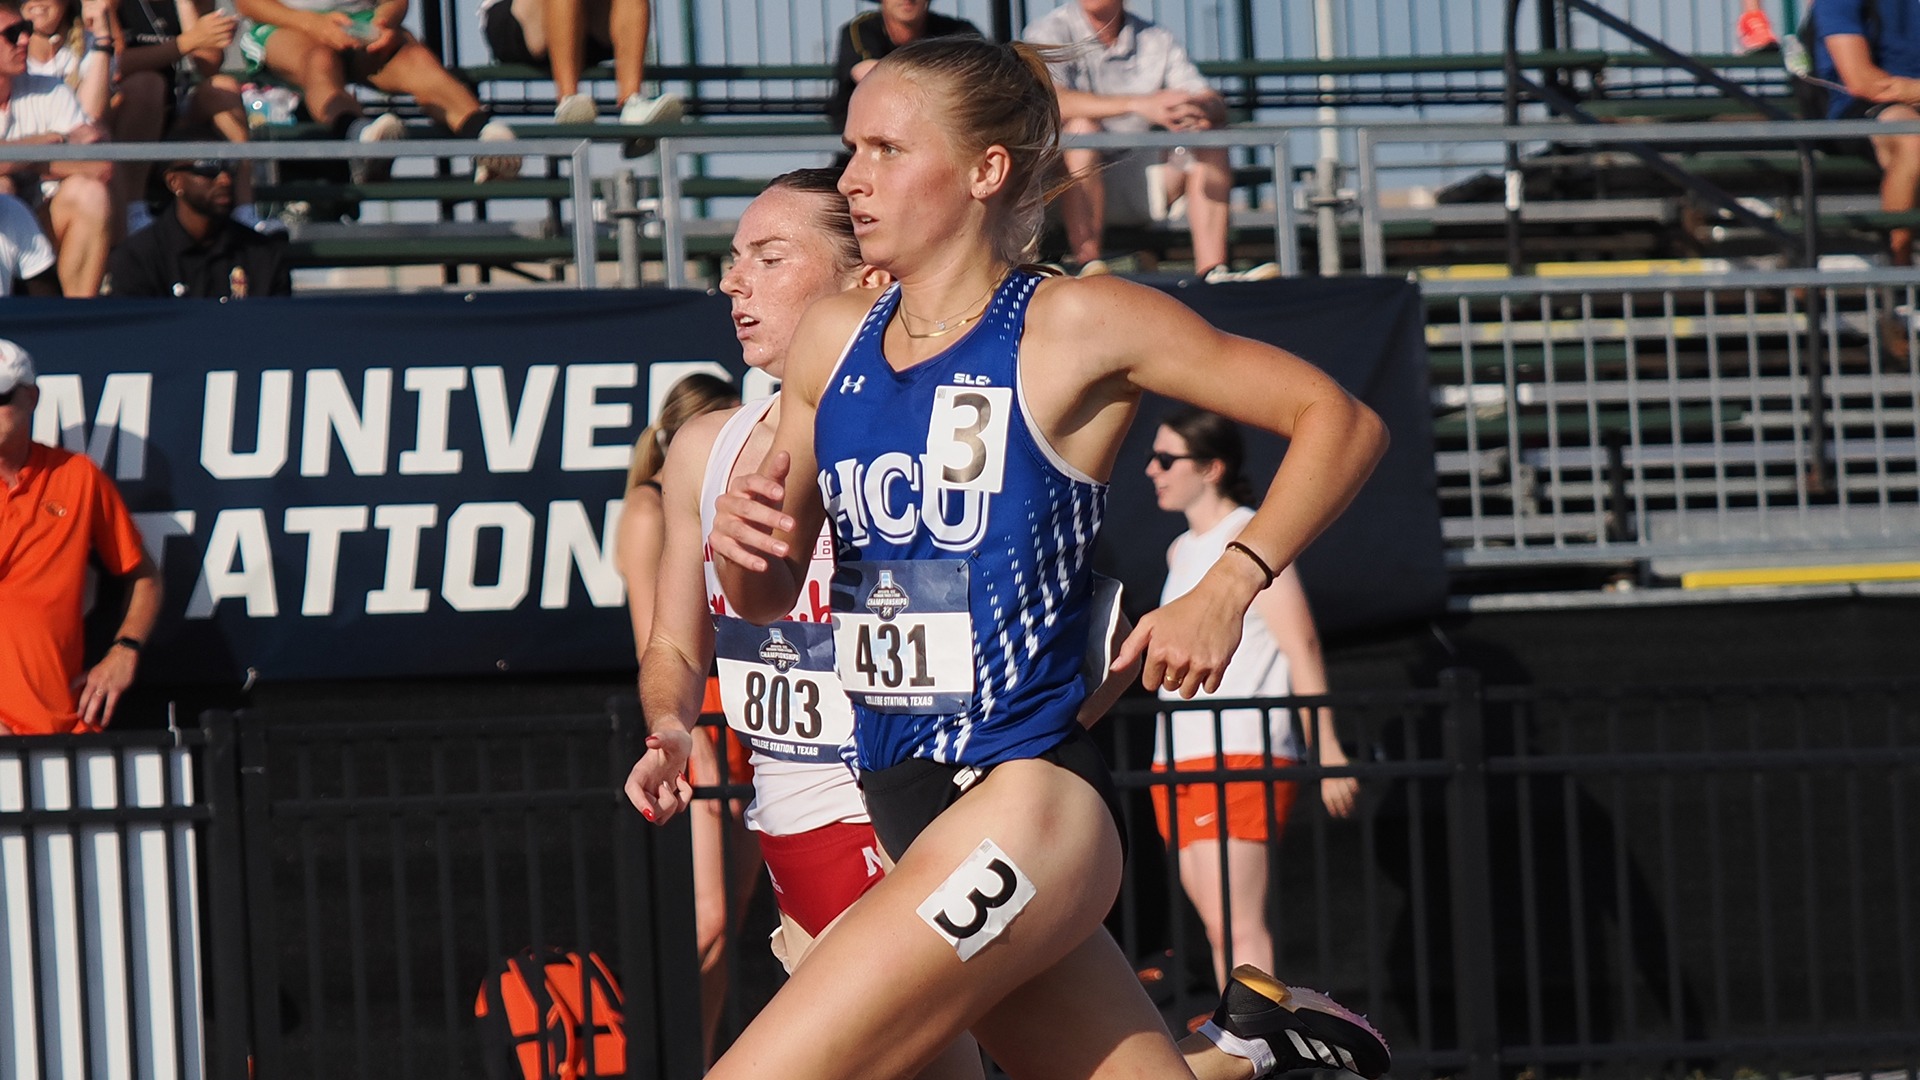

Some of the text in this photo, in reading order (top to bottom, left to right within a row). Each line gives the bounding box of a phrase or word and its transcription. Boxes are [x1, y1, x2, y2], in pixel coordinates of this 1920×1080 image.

[942, 392, 992, 484] 3
[817, 452, 990, 552] HCU
[82, 499, 628, 620] TATION
[856, 623, 935, 688] 431
[744, 670, 822, 739] 803
[910, 695, 934, 706] TEXAS
[796, 745, 819, 756] TEXAS
[933, 857, 1018, 939] 3
